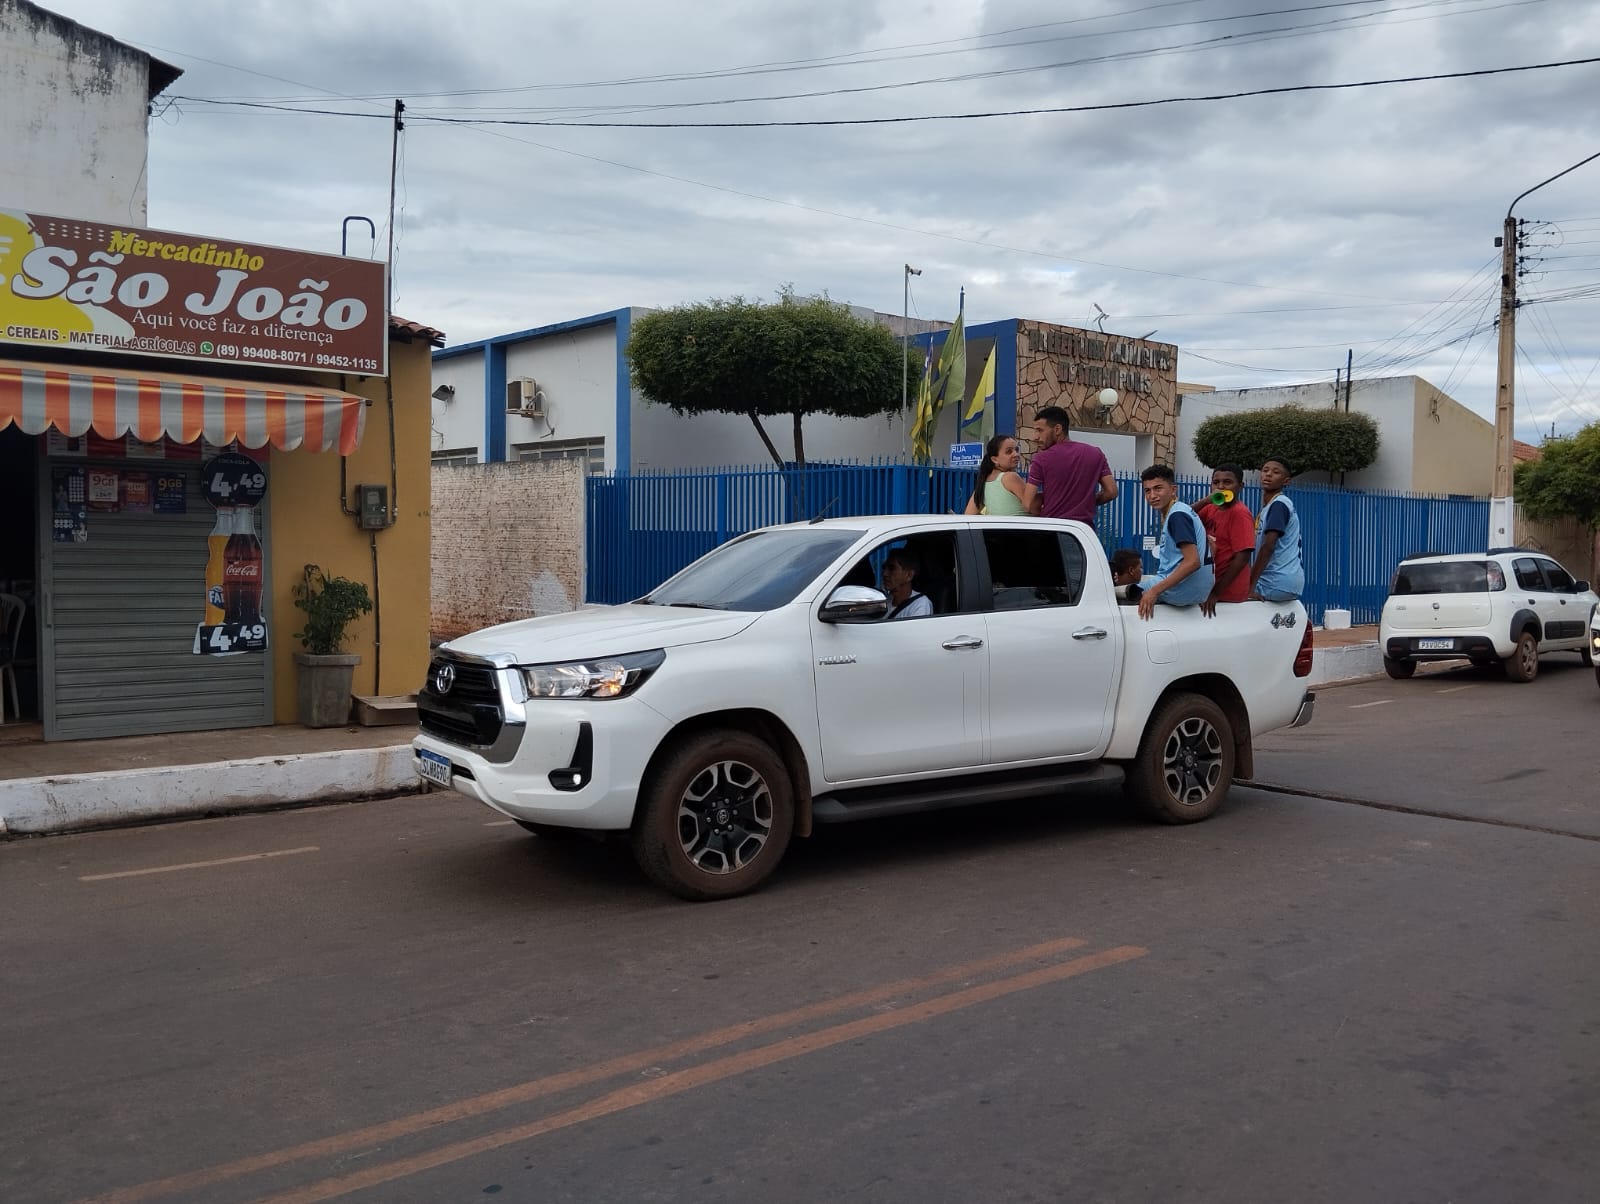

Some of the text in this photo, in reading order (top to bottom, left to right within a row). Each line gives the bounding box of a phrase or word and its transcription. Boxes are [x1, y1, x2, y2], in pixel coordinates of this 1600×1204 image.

[107, 230, 264, 271] Mercadinho
[11, 246, 368, 331] São João
[132, 309, 334, 346] Aqui você faz a diferença
[7, 325, 59, 341] CEREAIS
[69, 331, 130, 348] MATERIAL
[130, 335, 197, 355] AGRÍCOLAS
[216, 343, 240, 359] (89)
[242, 346, 307, 363] 99408-8071
[316, 354, 378, 370] 99452-1135
[952, 445, 967, 454] RUA
[211, 472, 266, 497] 4,49
[209, 623, 265, 651] 4,49
